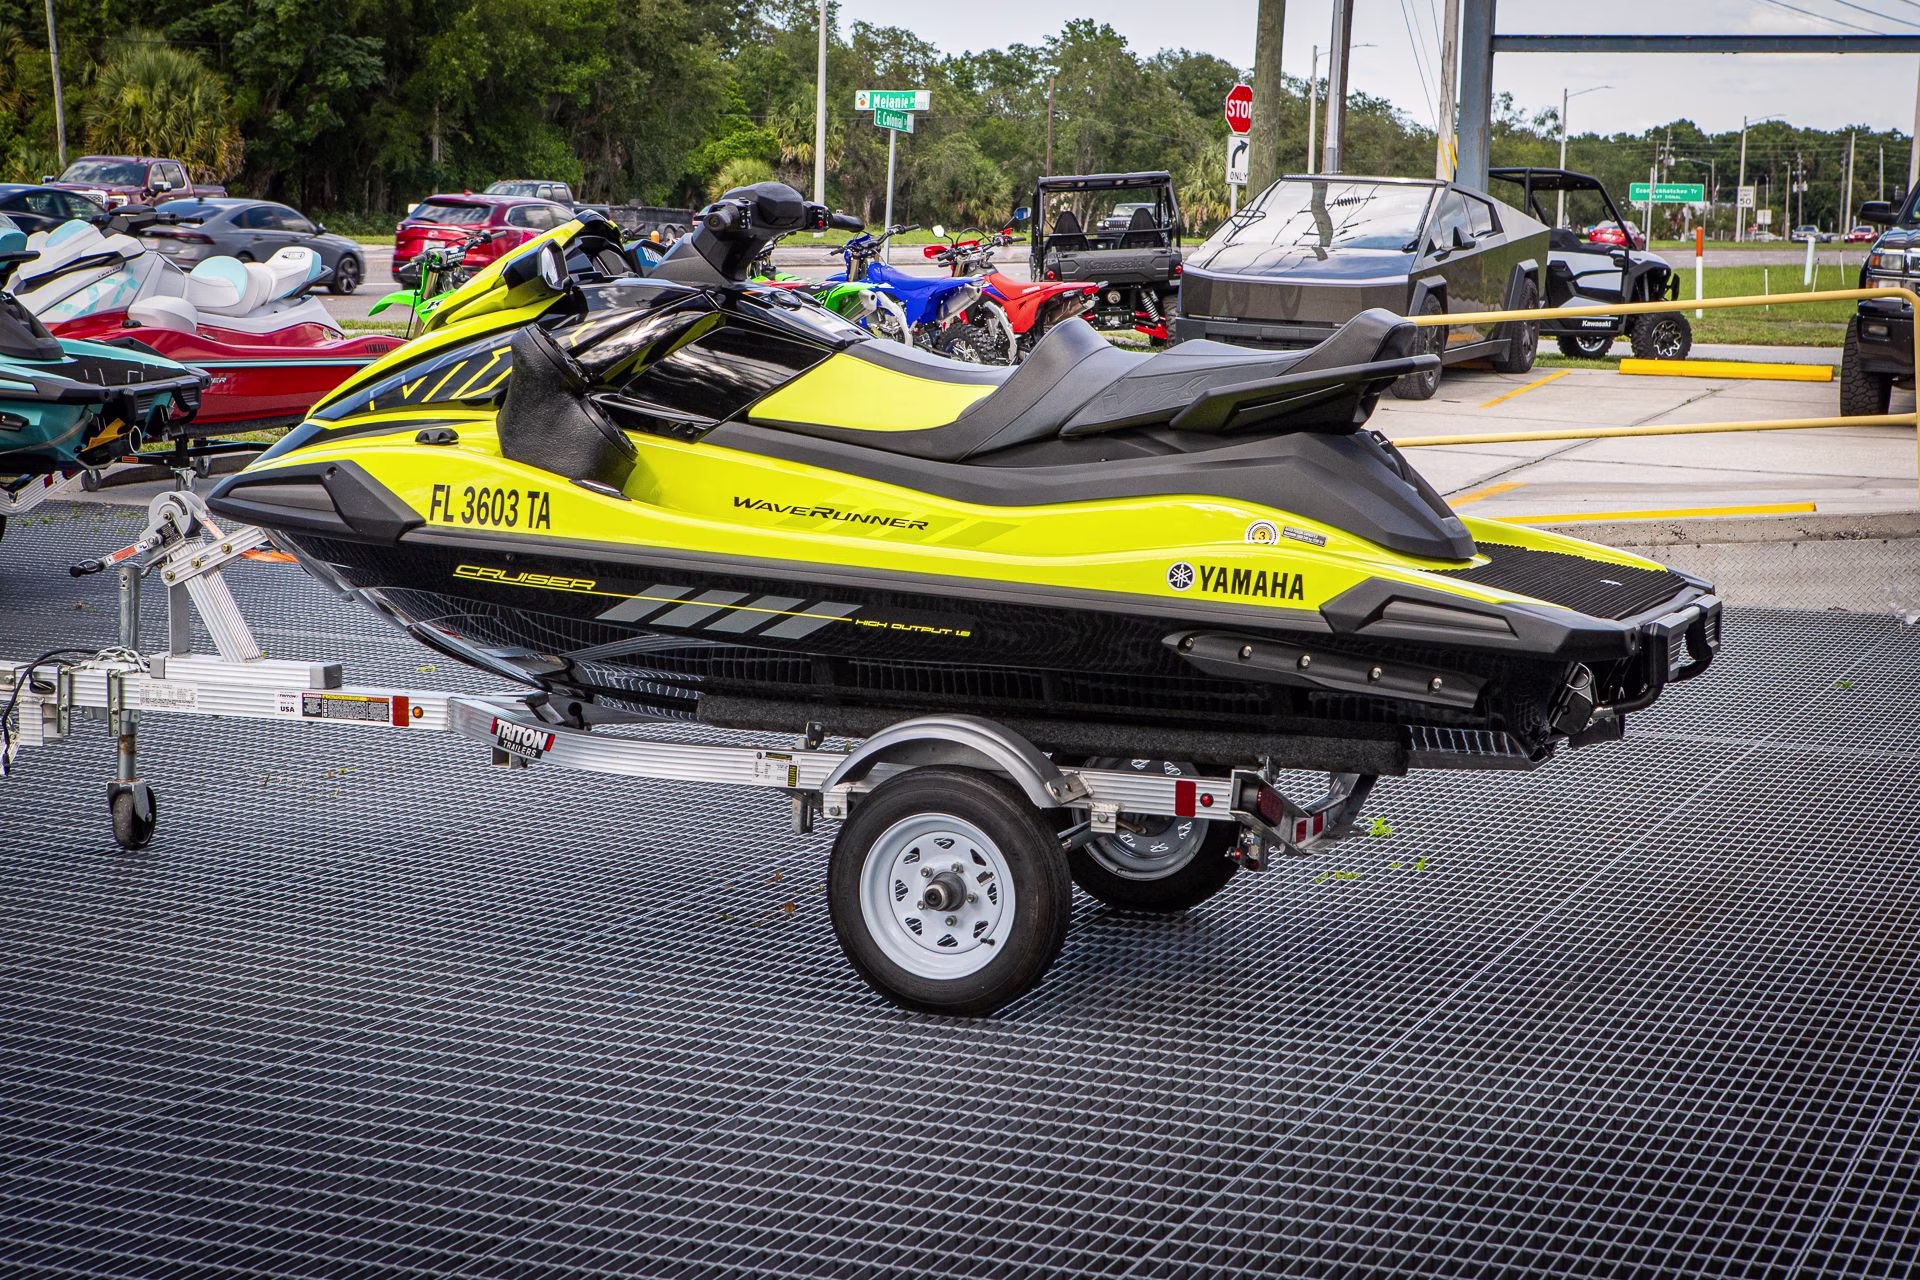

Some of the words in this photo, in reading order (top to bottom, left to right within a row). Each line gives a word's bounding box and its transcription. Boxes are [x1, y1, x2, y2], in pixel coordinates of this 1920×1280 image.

[873, 93, 909, 108] Melanie
[877, 110, 881, 125] E
[883, 111, 904, 128] Colonial
[1230, 171, 1248, 181] ONLY
[1740, 198, 1751, 206] 50
[1582, 320, 1611, 328] Kawasaki
[429, 484, 454, 523] FL
[461, 486, 519, 527] 3603
[527, 490, 550, 529] TA
[1258, 531, 1267, 541] 3
[455, 564, 597, 590] CRUISER
[1200, 565, 1304, 600] YAMAHA
[855, 619, 888, 628] HIGH
[891, 623, 952, 635] OUTPUT
[496, 719, 549, 750] TRITON
[503, 740, 537, 758] TRAILERS
